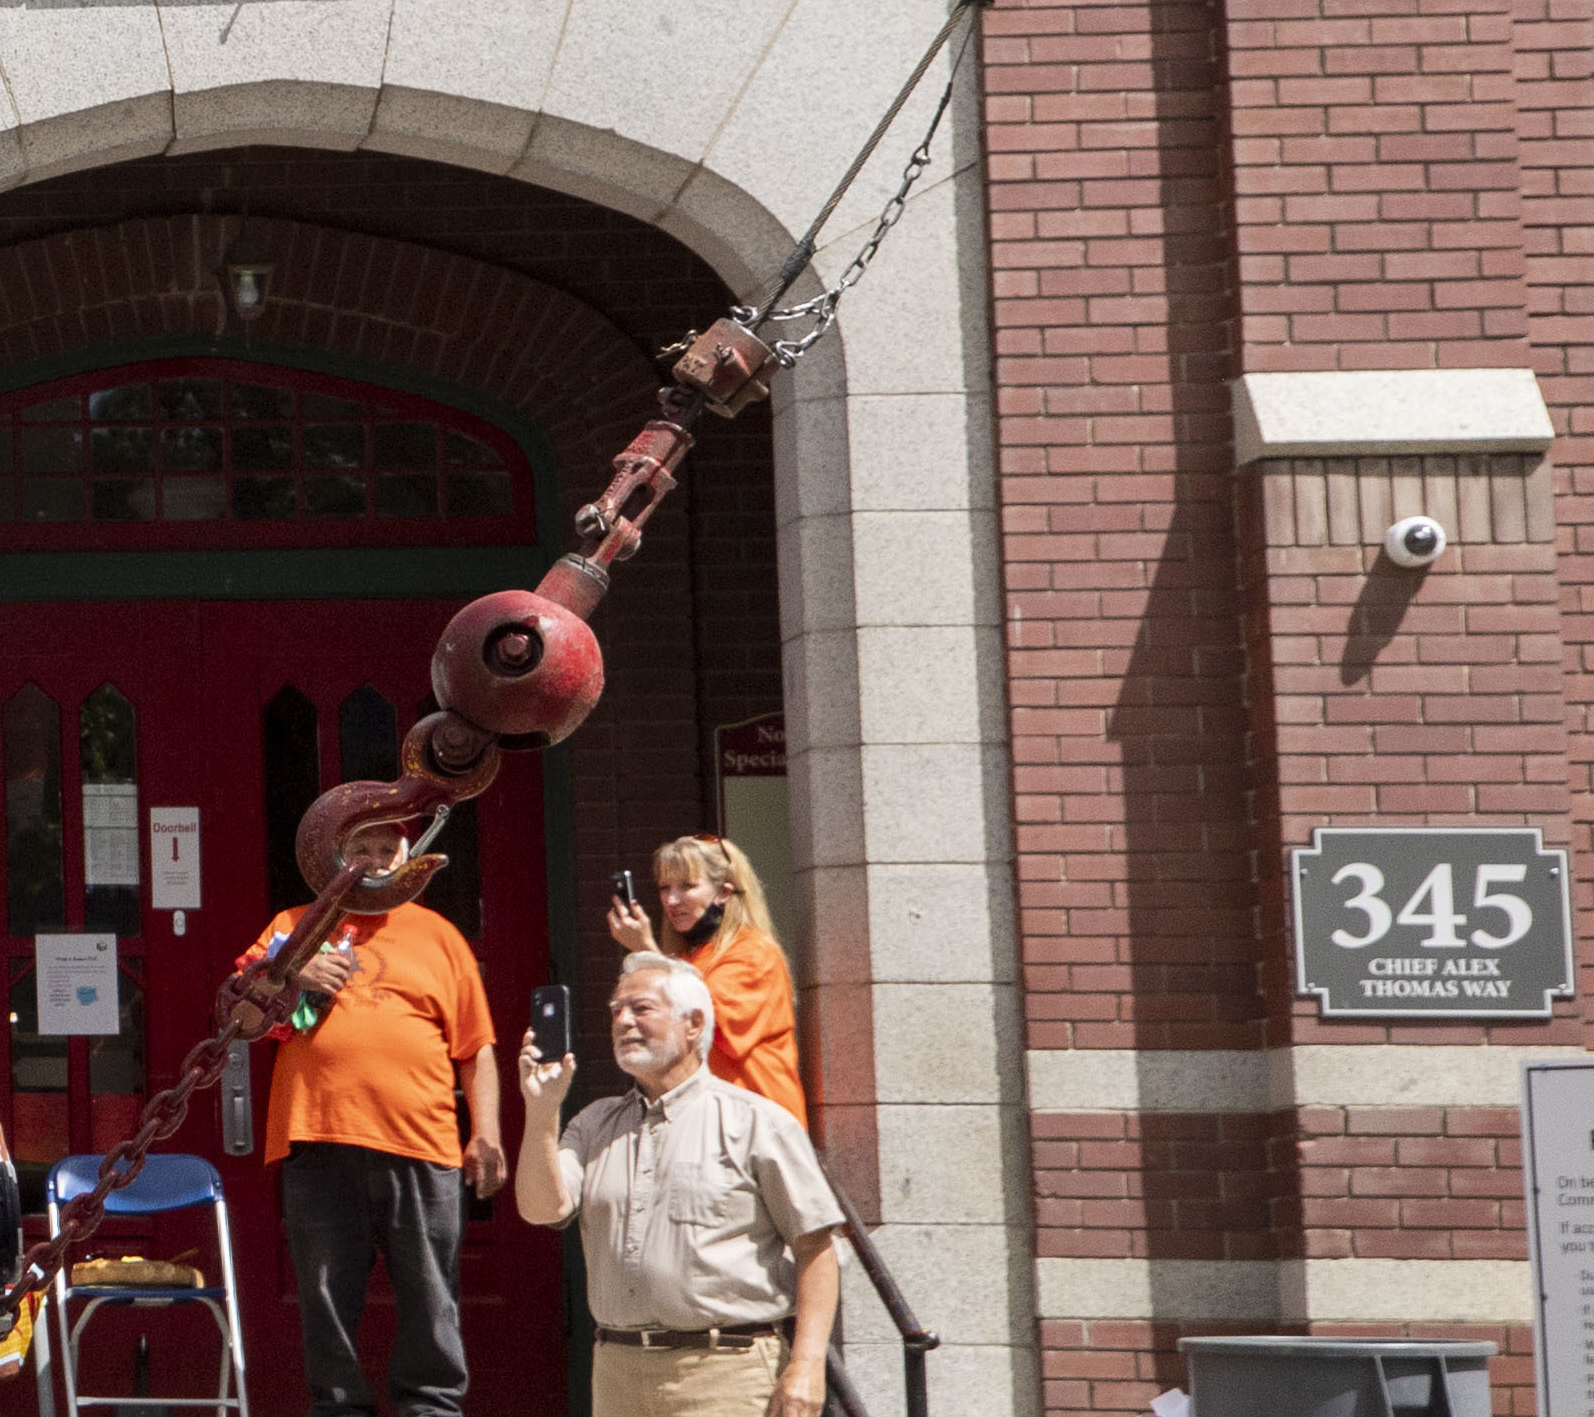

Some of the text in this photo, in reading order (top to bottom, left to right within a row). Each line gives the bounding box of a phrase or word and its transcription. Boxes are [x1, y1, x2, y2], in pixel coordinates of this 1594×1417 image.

[152, 823, 197, 833] Doorbell
[1330, 862, 1534, 949] 345
[1368, 957, 1501, 976] CHIEF ALEX
[1359, 979, 1512, 998] THOMAS WAY
